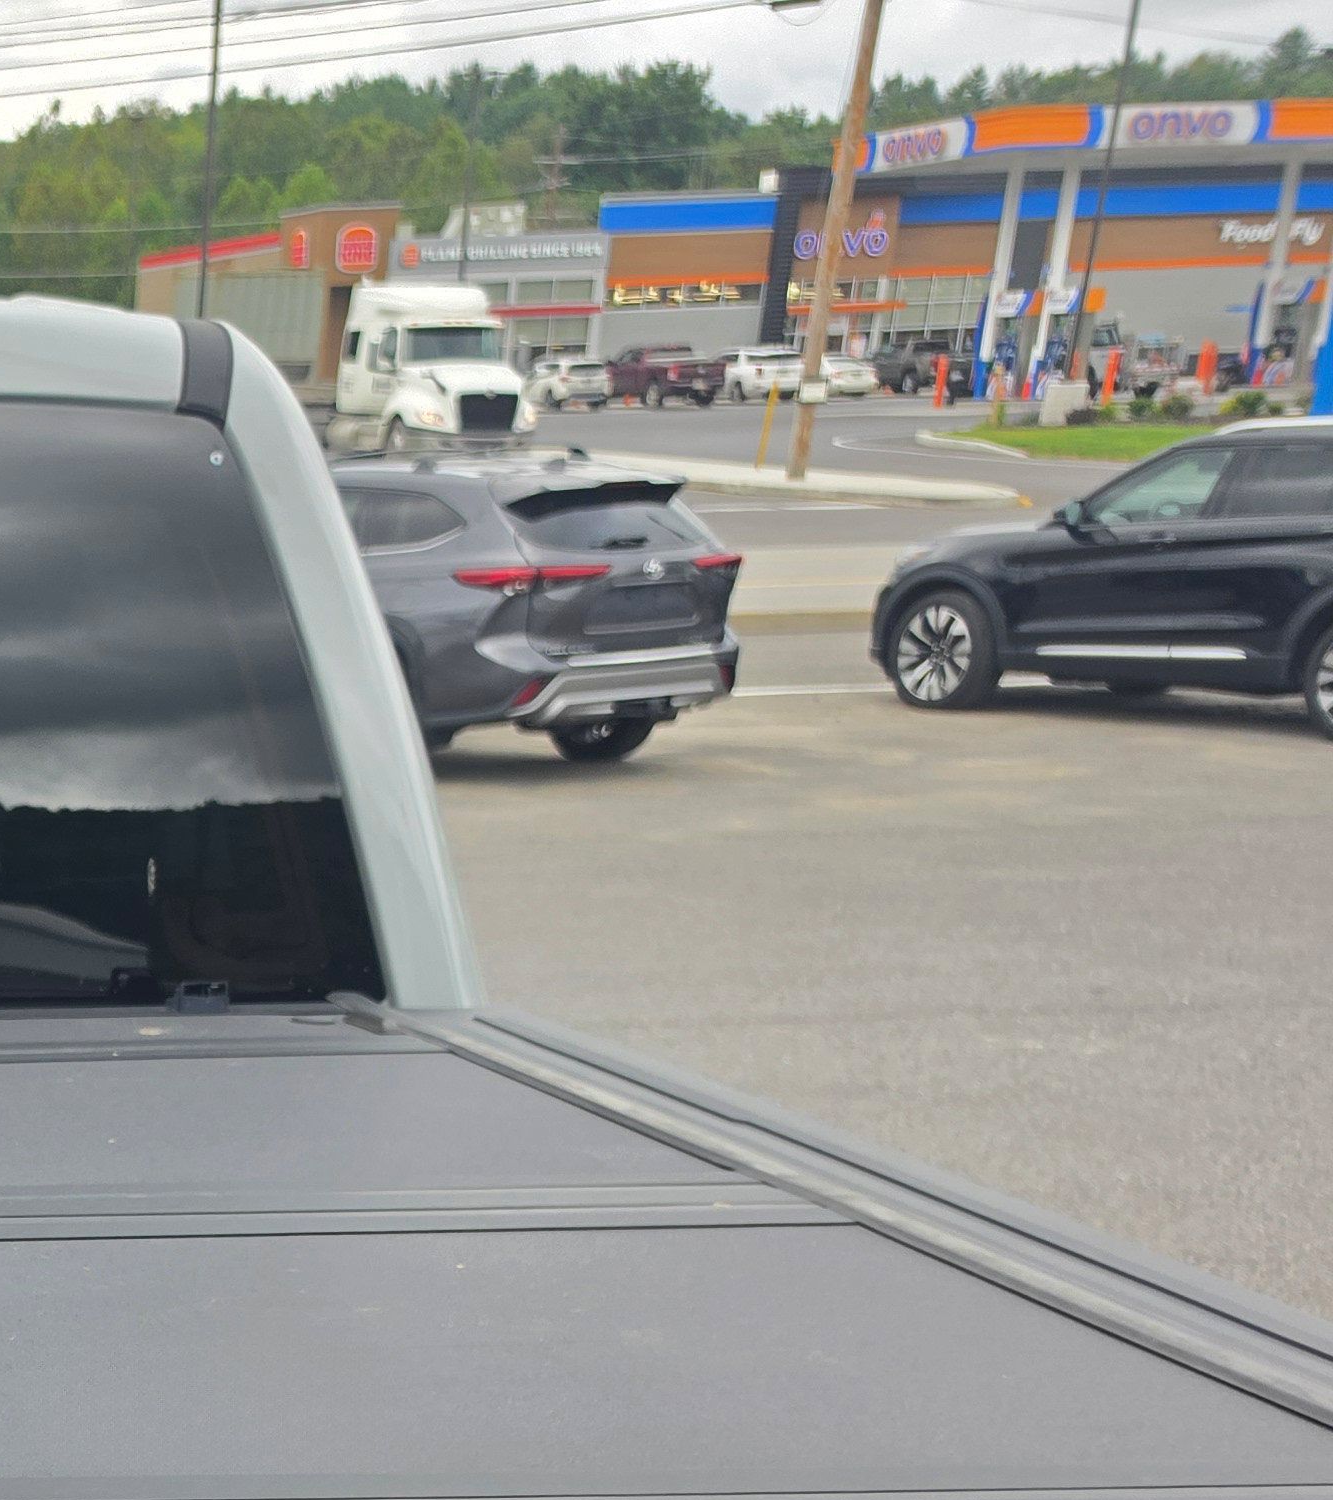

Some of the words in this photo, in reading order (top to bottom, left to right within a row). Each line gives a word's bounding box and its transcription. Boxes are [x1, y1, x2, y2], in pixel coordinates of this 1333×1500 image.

[1132, 110, 1234, 140] onvo
[882, 129, 944, 163] onvo
[794, 228, 890, 260] ovo
